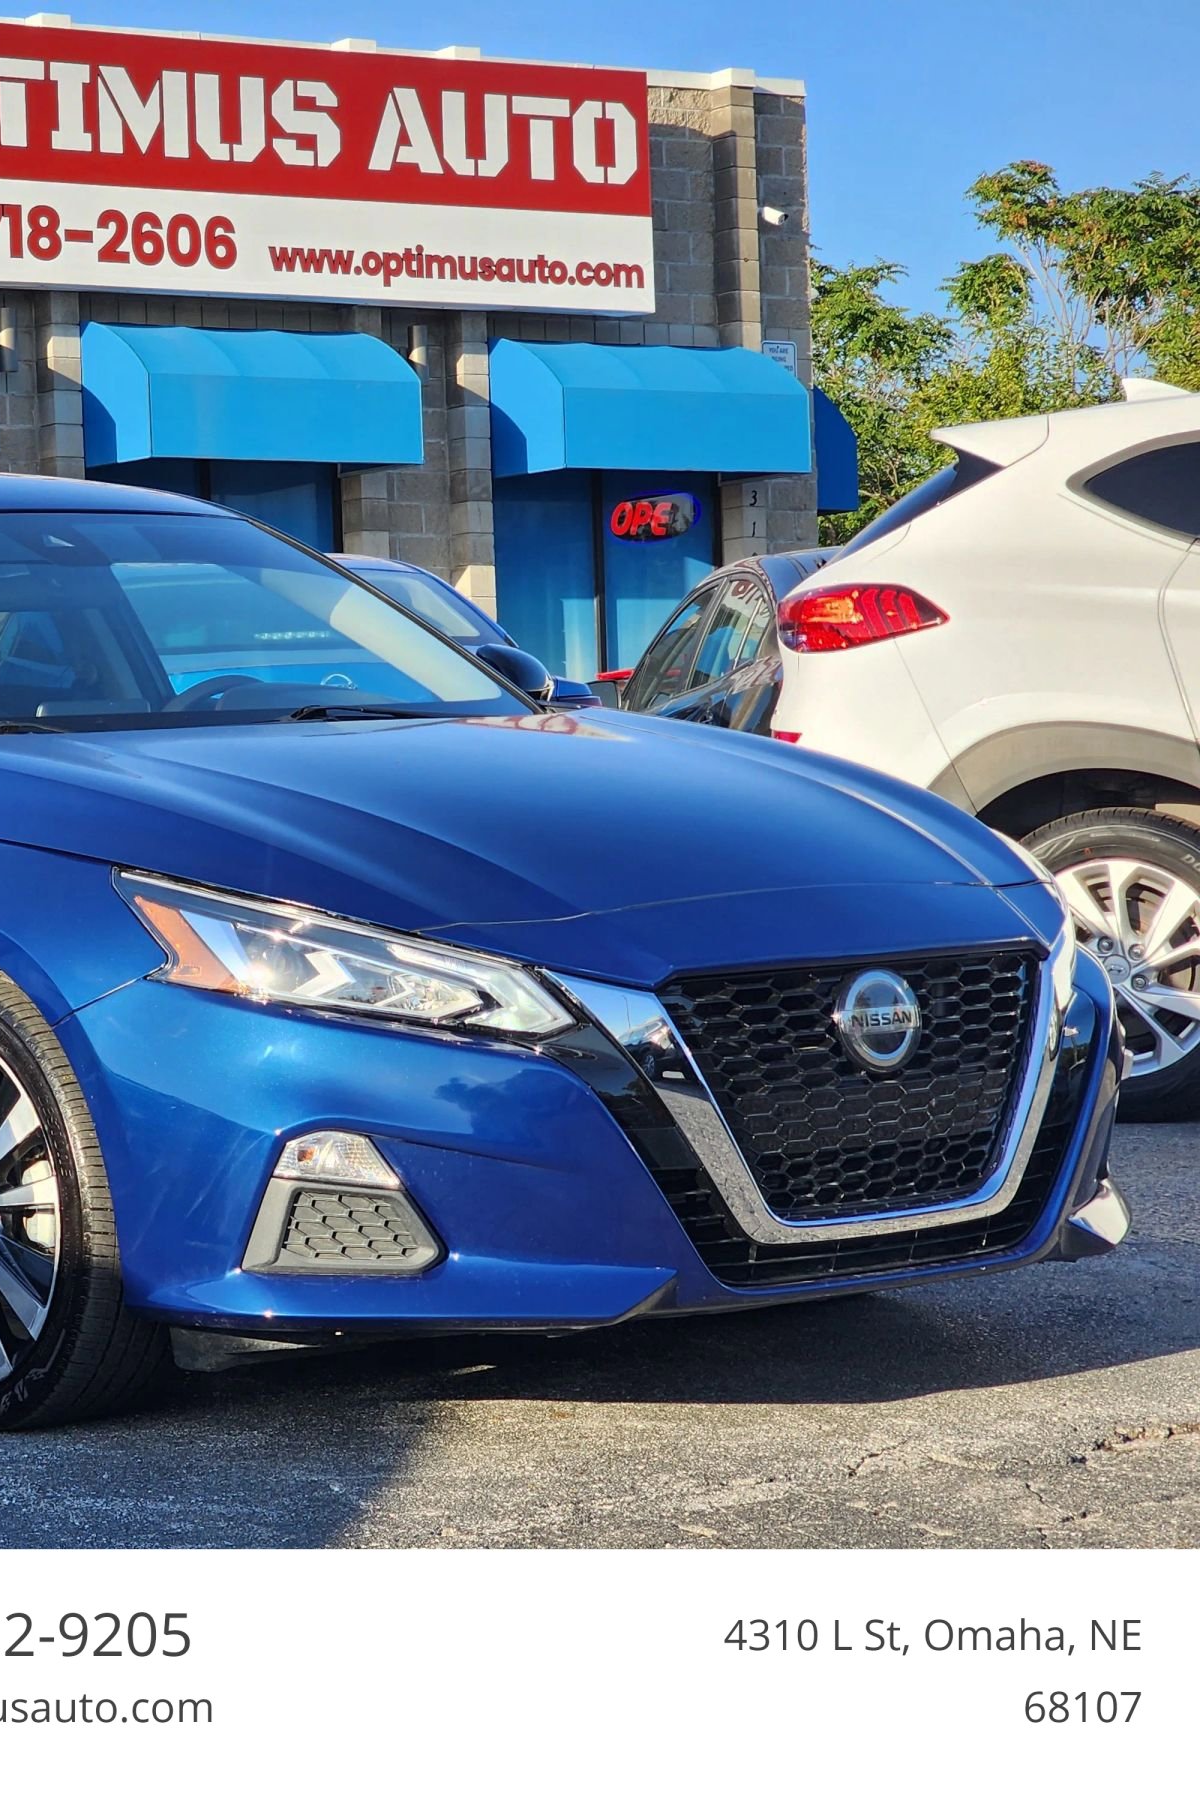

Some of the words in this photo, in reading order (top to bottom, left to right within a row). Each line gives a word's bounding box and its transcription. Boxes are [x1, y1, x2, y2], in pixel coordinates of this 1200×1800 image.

[367, 86, 638, 185] AUTO
[268, 244, 645, 289] www.optimusauto.com
[610, 501, 676, 536] OPE
[850, 1010, 912, 1028] NISSAN
